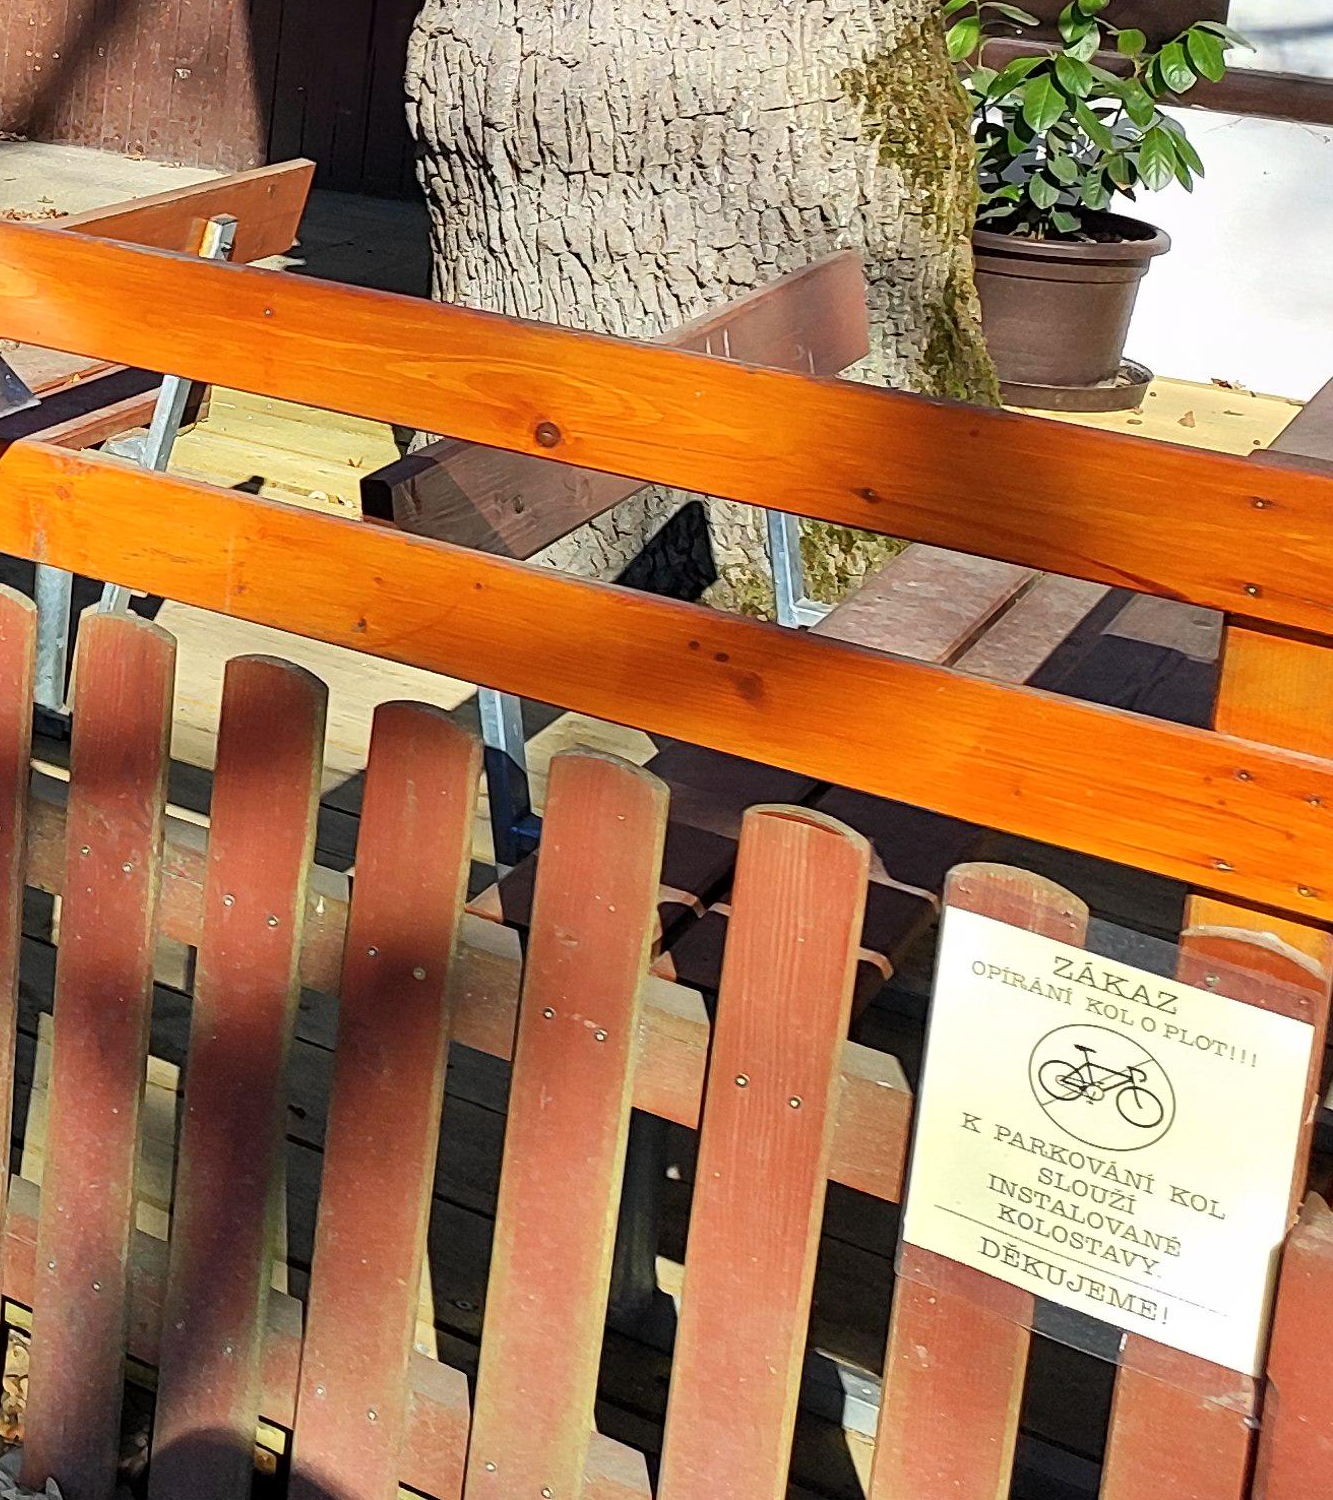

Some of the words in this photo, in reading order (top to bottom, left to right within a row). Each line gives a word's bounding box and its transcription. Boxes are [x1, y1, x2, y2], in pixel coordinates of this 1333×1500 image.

[971, 960, 1074, 1006] OPÍRÁNÍ
[1085, 996, 1135, 1026] KOL
[1140, 1016, 1156, 1033] O
[1162, 1022, 1257, 1068] PLOT!!!
[1052, 956, 1179, 1015] ZÁKAZ
[961, 1111, 982, 1134] K
[993, 1124, 1156, 1195] PARKOVÁNÍ
[1169, 1184, 1226, 1220] KOL
[1037, 1167, 1137, 1216] SLOUŽÍ
[986, 1173, 1182, 1258] INSTALOVANÉ
[978, 1236, 1170, 1326] DĚKUJEME!
